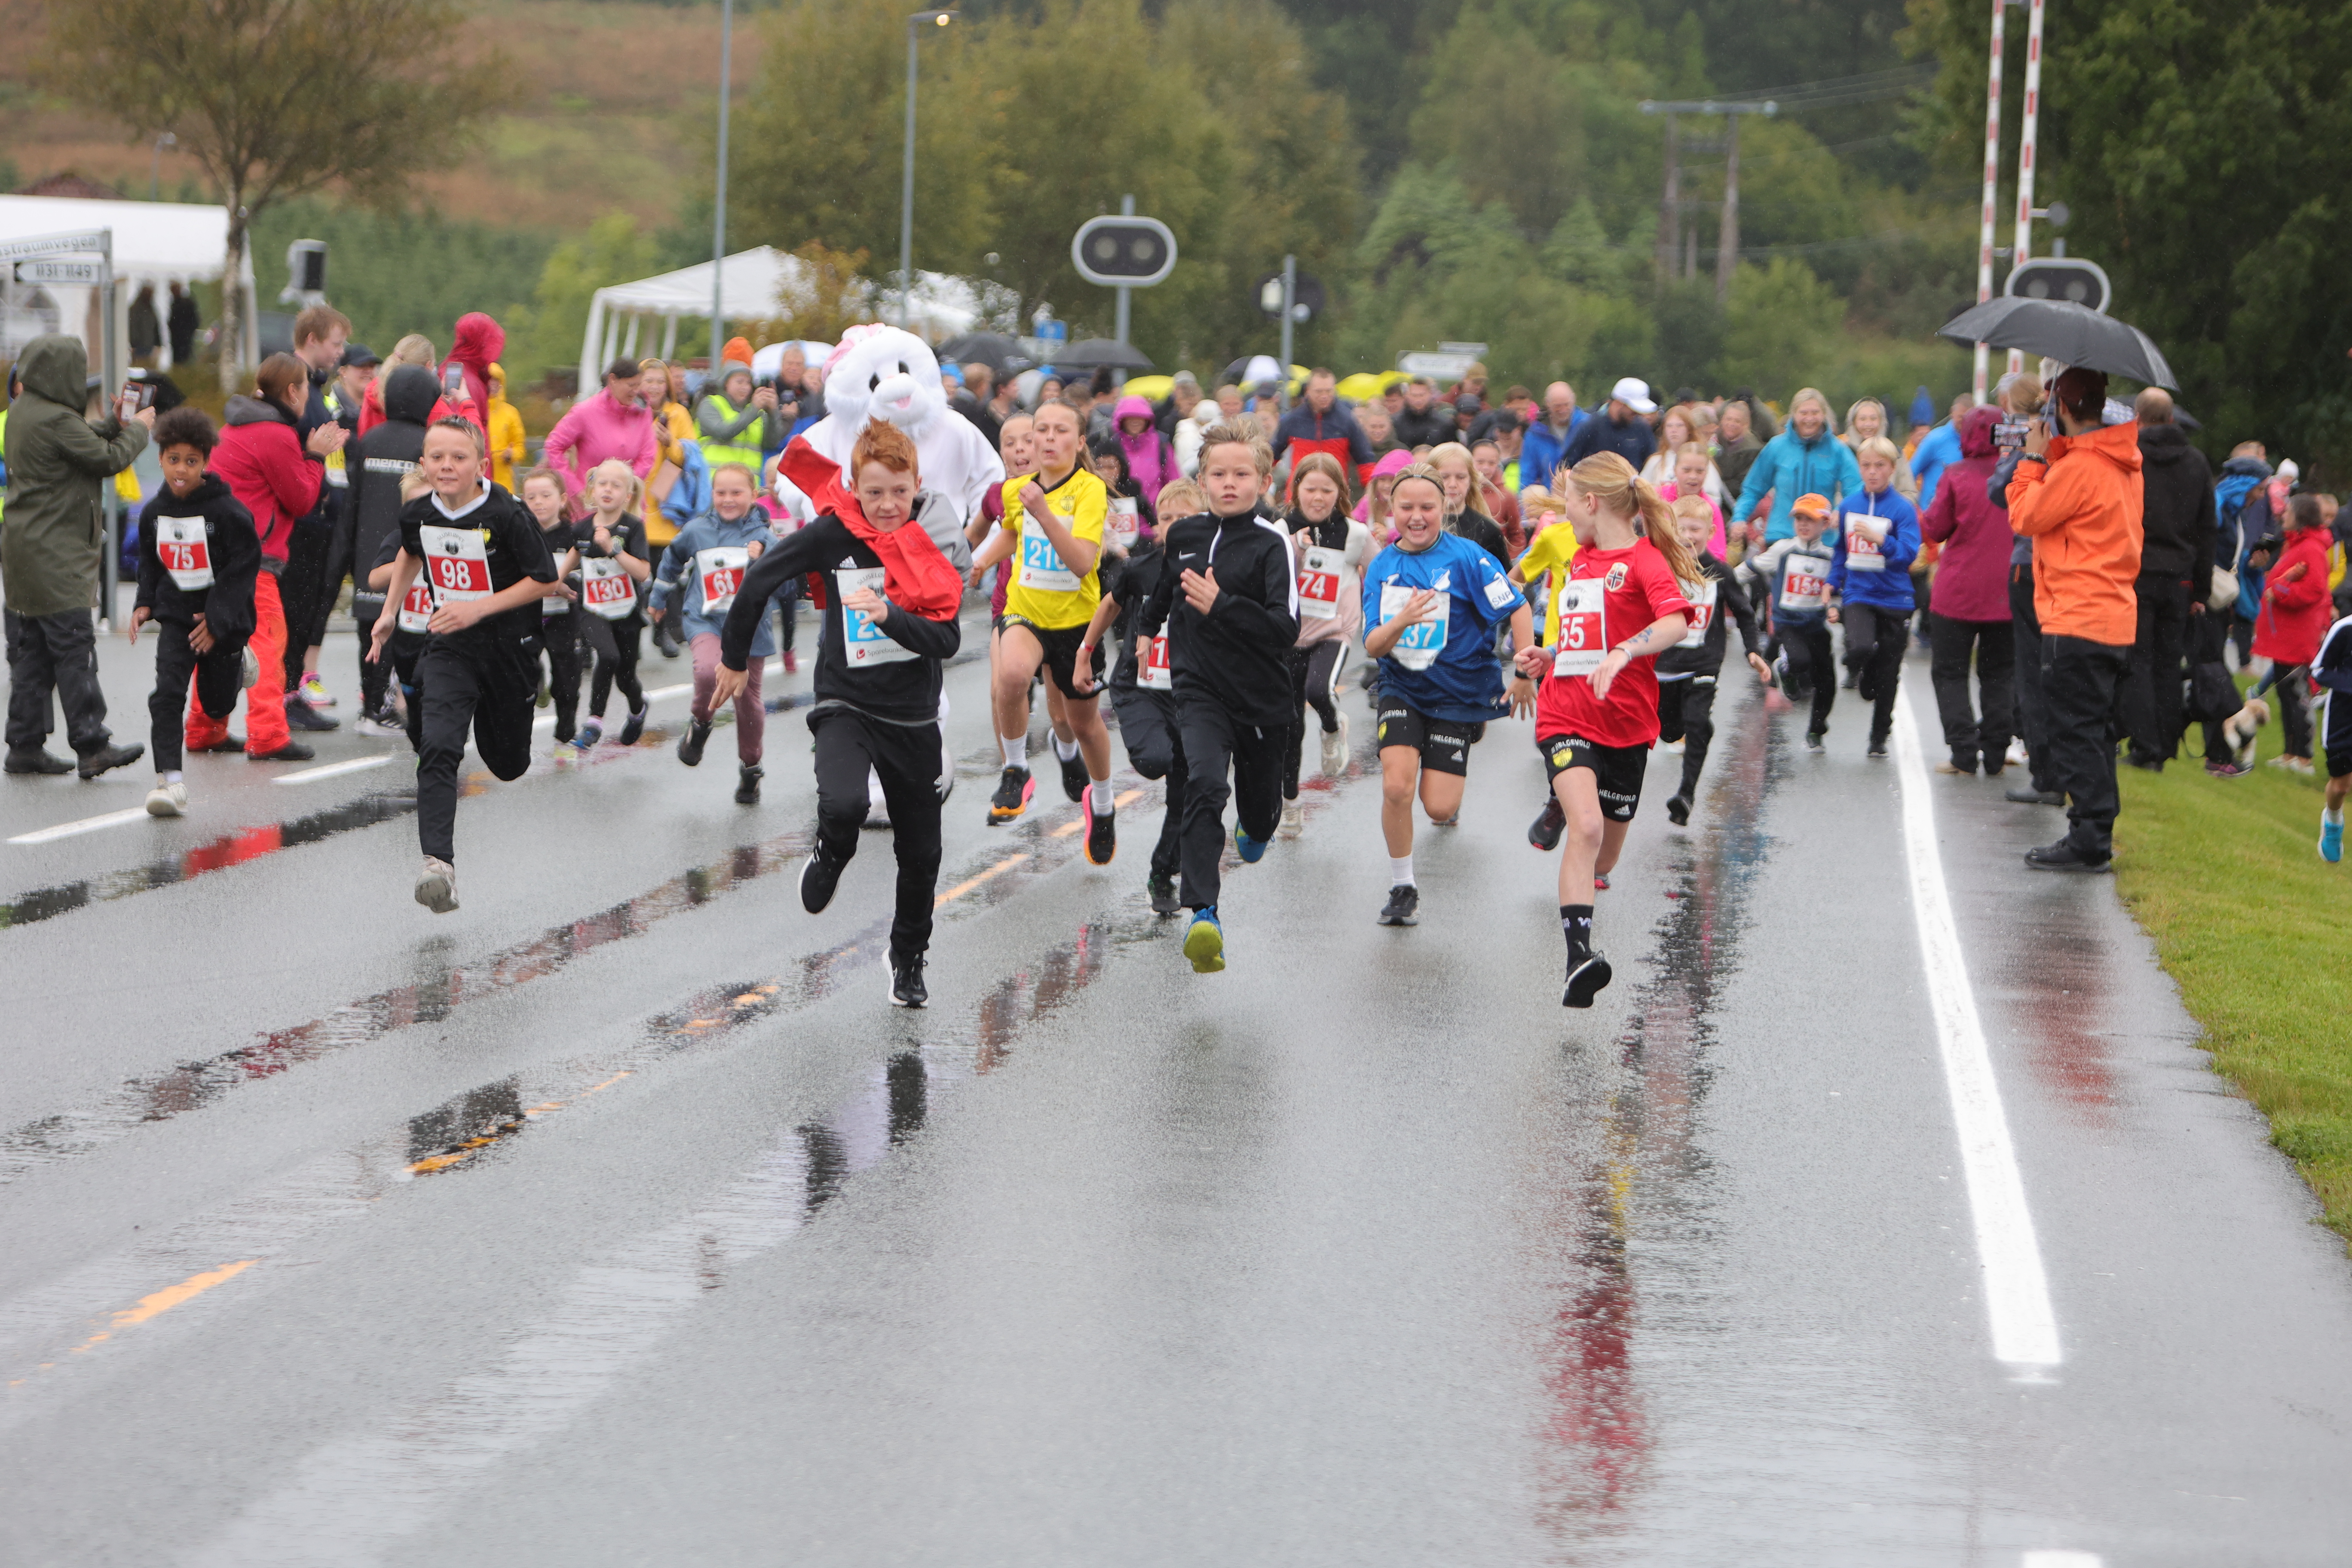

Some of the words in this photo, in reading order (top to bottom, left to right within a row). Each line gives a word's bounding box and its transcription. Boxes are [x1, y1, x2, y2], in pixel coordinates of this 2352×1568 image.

[437, 531, 465, 543] SLUSELØPET
[168, 544, 195, 569] 75
[441, 558, 472, 590] 98
[1032, 575, 1073, 583] SparebankenVest
[1299, 571, 1326, 599] 74
[590, 577, 626, 601] 130
[1491, 591, 1511, 606] SNP
[854, 609, 887, 639] 2
[1688, 605, 1707, 628] 3
[1560, 616, 1585, 649] 55
[1154, 639, 1170, 667] 1
[1433, 734, 1465, 746] HELGEVOLD
[1555, 738, 1591, 751] HELGEVOLD
[1553, 747, 1571, 759] SKJOLD
[1599, 789, 1636, 802] HELGEVOLD
